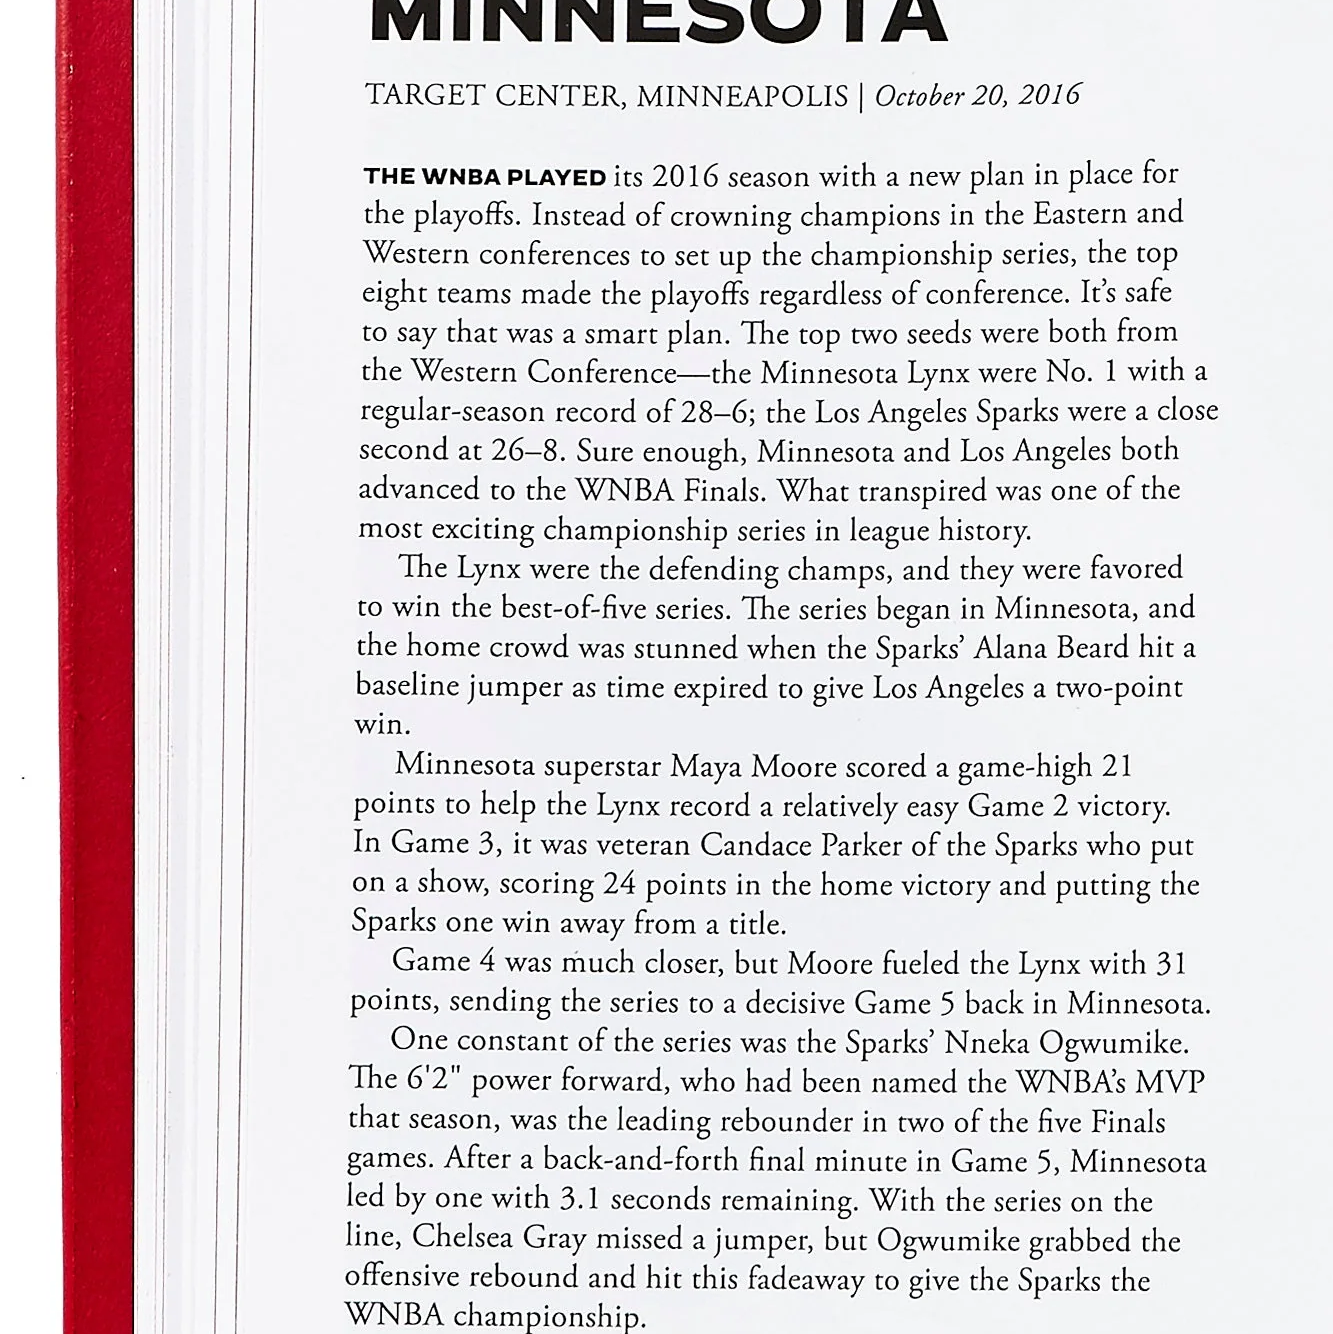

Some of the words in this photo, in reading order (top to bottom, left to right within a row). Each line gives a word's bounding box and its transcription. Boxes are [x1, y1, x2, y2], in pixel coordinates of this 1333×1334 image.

[364, 82, 487, 106] TARGET
[495, 83, 627, 111] CENTER,
[636, 84, 848, 108] MINNEAPOLIS
[875, 82, 966, 107] October
[970, 83, 1008, 108] 20,
[1017, 81, 1084, 105] 2016
[362, 167, 416, 185] THE
[421, 167, 502, 186] WNBA
[507, 168, 607, 187] PLAYED
[613, 164, 643, 188] its
[652, 162, 719, 188] 2016
[728, 171, 810, 188] season
[818, 161, 877, 188] with
[886, 171, 900, 187] a
[908, 171, 962, 187] new
[969, 160, 1025, 195] plan
[1034, 162, 1059, 185] in
[1068, 159, 1133, 194] place
[1142, 158, 1180, 184] for
[362, 277, 428, 312] eight
[437, 286, 512, 305] teams
[521, 279, 591, 305] made
[601, 279, 642, 305] the
[650, 279, 750, 314] playoffs
[759, 279, 882, 314] regardless
[891, 279, 922, 306] of
[926, 278, 1070, 305] conference.
[1125, 276, 1172, 303] safe
[360, 395, 545, 430] regular-season
[555, 397, 637, 423] record
[646, 397, 677, 424] of
[766, 398, 806, 424] the
[815, 399, 860, 424] Los
[867, 397, 967, 432] Angeles
[976, 396, 1059, 431] Sparks
[1067, 405, 1127, 422] were
[1135, 405, 1149, 421] a
[1157, 395, 1219, 421] close
[358, 521, 423, 539] most
[431, 516, 535, 549] exciting
[543, 514, 728, 550] championship
[737, 518, 806, 542] series
[815, 518, 840, 542] in
[849, 516, 930, 550] league
[938, 515, 1031, 549] history.
[356, 669, 460, 697] baseline
[466, 673, 564, 706] jumper
[572, 682, 596, 698] as
[606, 675, 665, 699] time
[673, 673, 768, 707] expired
[778, 682, 803, 699] to
[812, 676, 864, 708] give
[872, 674, 918, 699] Los
[924, 673, 1024, 708] Angeles
[1033, 682, 1047, 699] a
[1055, 674, 1184, 706] two-point
[395, 750, 536, 776] Minnesota
[544, 759, 662, 785] superstar
[670, 752, 743, 785] Maya
[751, 753, 837, 778] Moore
[845, 752, 927, 778] scored
[936, 762, 950, 778] a
[958, 751, 1093, 786] game-high
[1102, 753, 1131, 777] 21
[351, 906, 437, 940] Sparks
[446, 916, 494, 933] one
[502, 910, 551, 933] win
[560, 918, 626, 942] away
[634, 908, 697, 935] from
[706, 919, 720, 935] a
[729, 909, 786, 935] title.
[390, 1025, 448, 1050] One
[457, 1034, 569, 1052] constant
[578, 1026, 609, 1052] of
[614, 1026, 654, 1053] the
[662, 1030, 732, 1053] series
[740, 1037, 787, 1054] was
[797, 1027, 837, 1054] the
[944, 1028, 1030, 1054] Nneka
[1039, 1028, 1189, 1063] Ogwumike.
[346, 1151, 434, 1176] games.
[443, 1142, 512, 1169] After
[520, 1154, 534, 1170] a
[543, 1144, 739, 1172] back-and-forth
[749, 1145, 805, 1172] final
[814, 1149, 907, 1173] minute
[916, 1149, 941, 1173] in
[951, 1147, 1028, 1173] Game
[1037, 1148, 1060, 1177] 5,
[1070, 1148, 1207, 1173] Minnesota
[343, 1301, 445, 1326] WNBA
